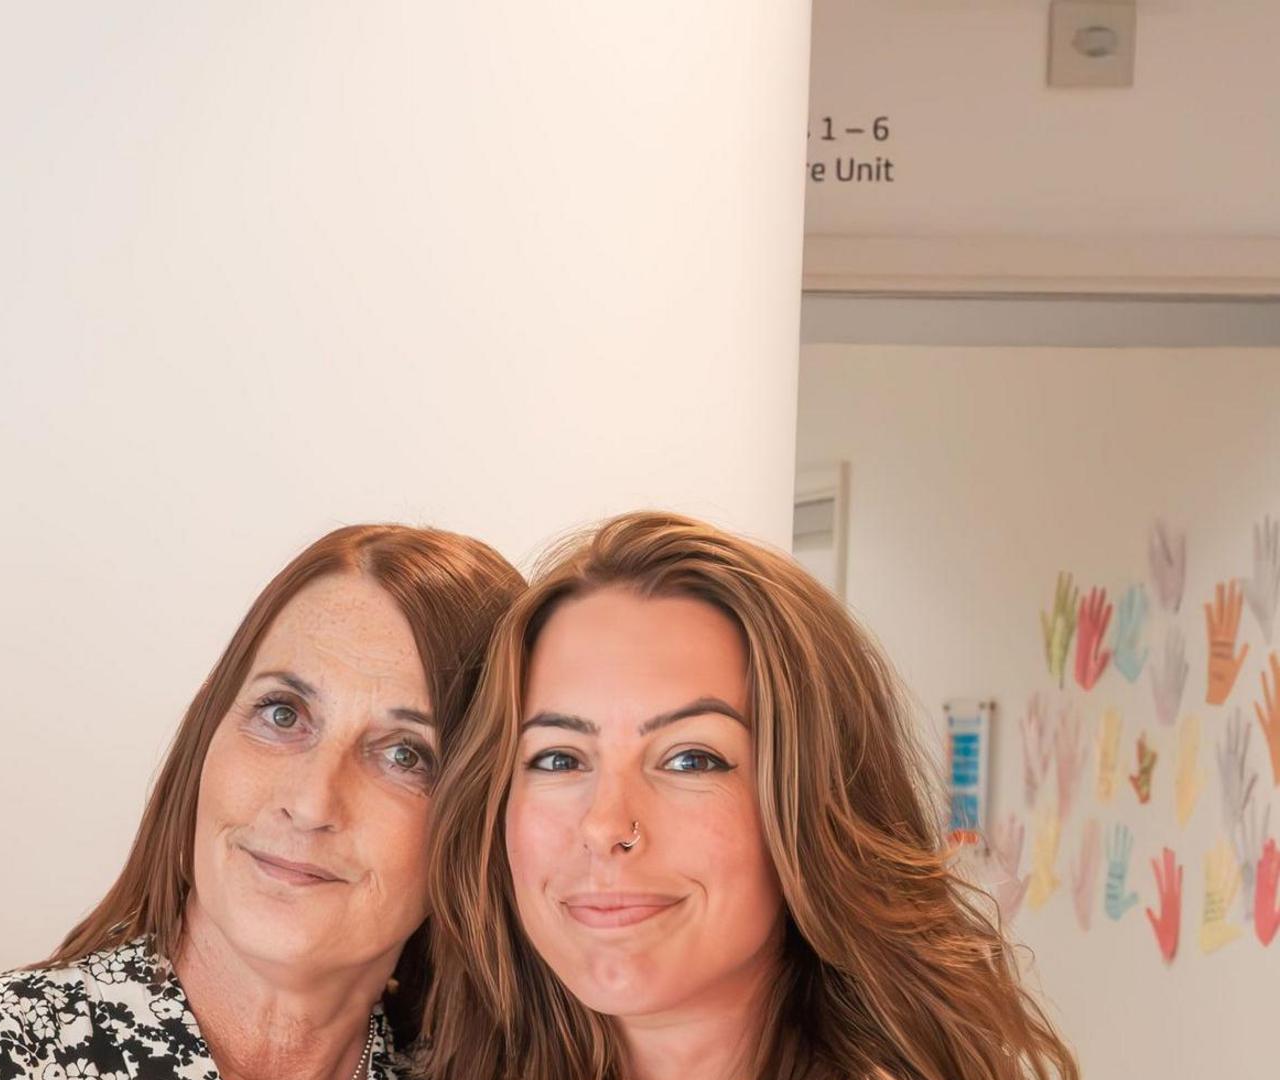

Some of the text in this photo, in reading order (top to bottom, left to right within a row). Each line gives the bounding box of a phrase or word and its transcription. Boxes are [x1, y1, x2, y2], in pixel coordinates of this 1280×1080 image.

[821, 116, 837, 141] 1
[873, 116, 889, 141] 6
[836, 156, 894, 182] Unit
